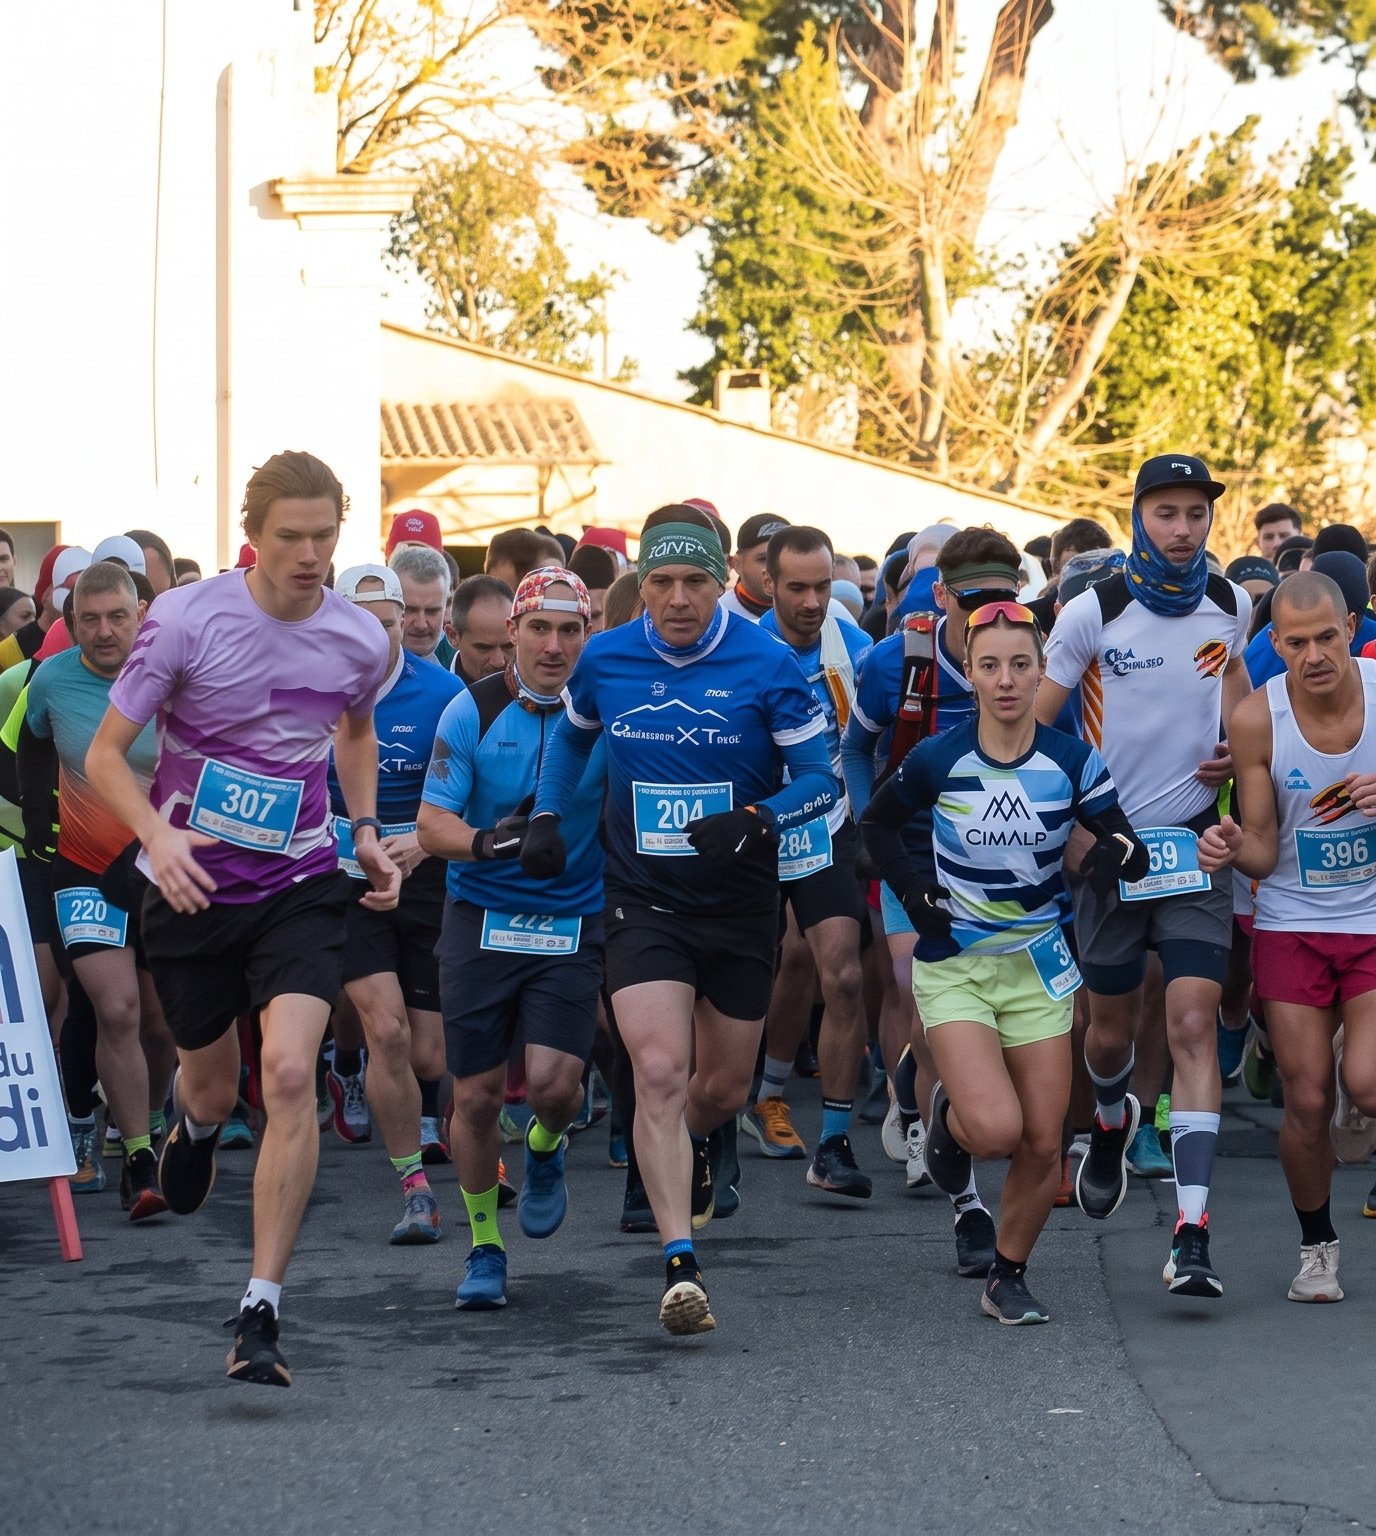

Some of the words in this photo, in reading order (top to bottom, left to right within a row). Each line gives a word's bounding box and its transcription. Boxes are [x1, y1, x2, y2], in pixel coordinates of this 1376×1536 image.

[221, 783, 277, 822] 307
[657, 799, 704, 829] 204
[778, 829, 813, 858] 284
[965, 828, 1047, 847] CIMALP
[1320, 837, 1368, 868] 396
[70, 898, 108, 922] 220
